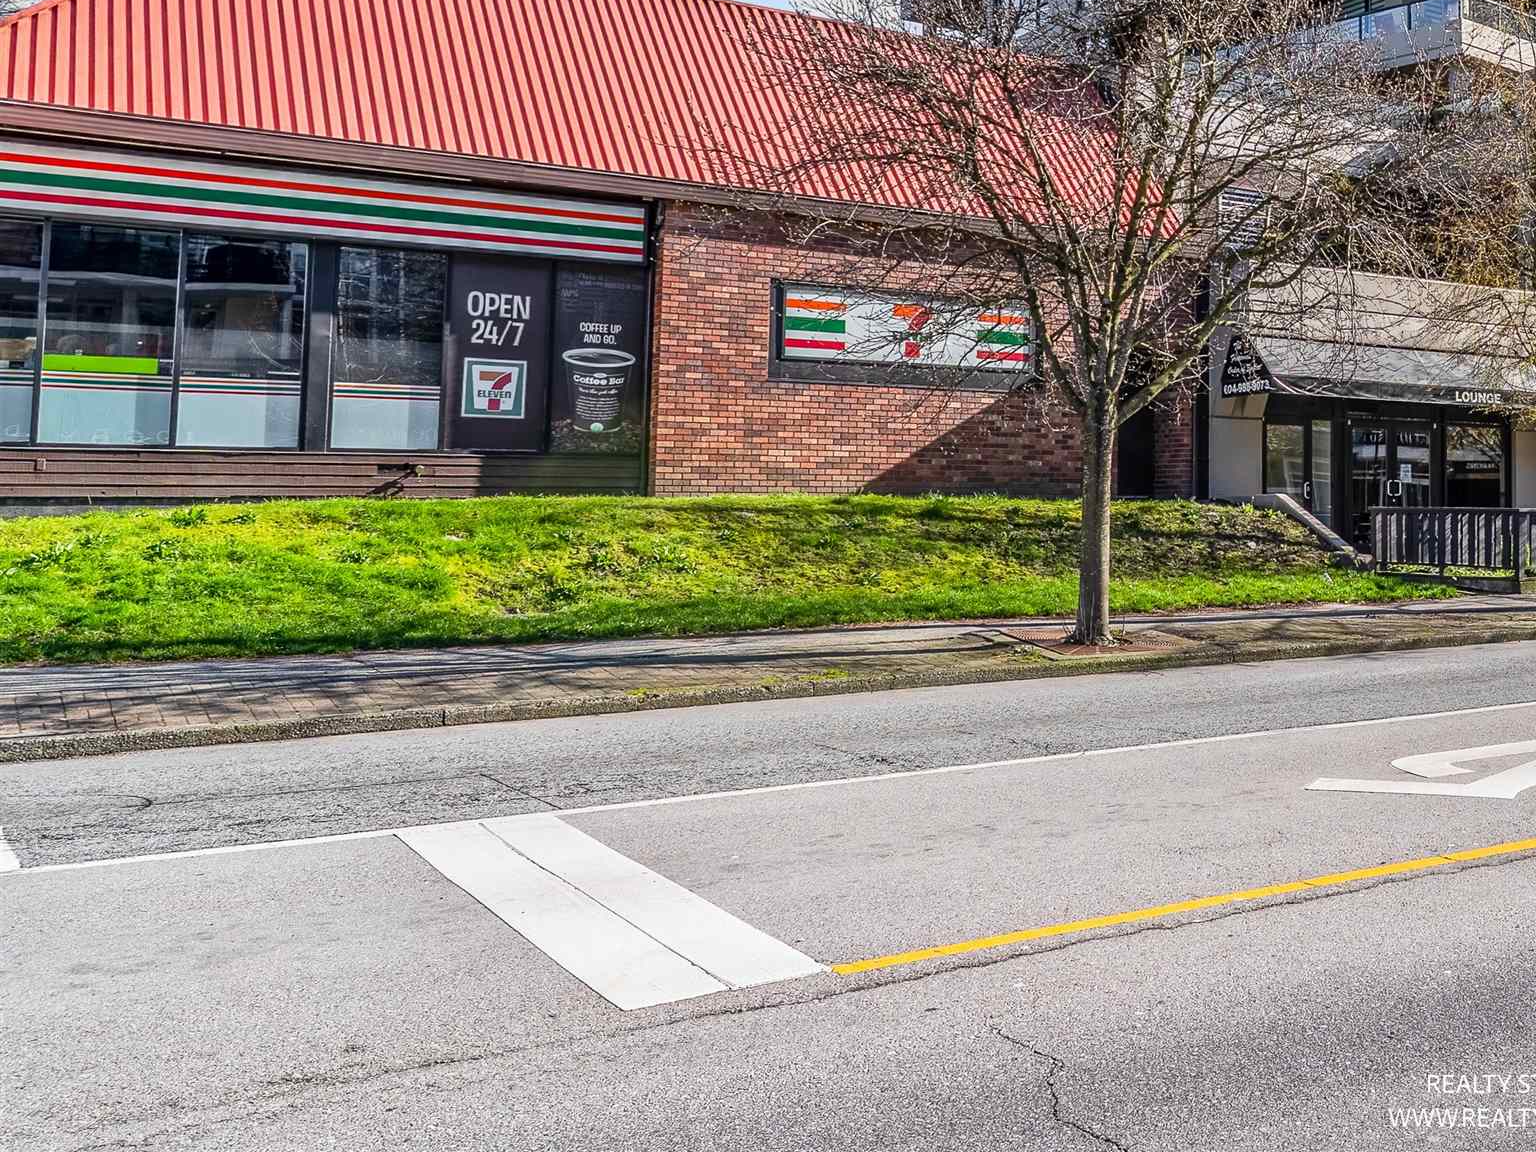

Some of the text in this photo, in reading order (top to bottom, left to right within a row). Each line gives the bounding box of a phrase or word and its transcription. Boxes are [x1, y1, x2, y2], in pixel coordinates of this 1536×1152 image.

[466, 291, 532, 320] OPEN
[470, 319, 525, 346] 24/7
[579, 321, 623, 334] COFFEE UP
[583, 333, 601, 344] AND
[1455, 391, 1502, 404] LOUNGE
